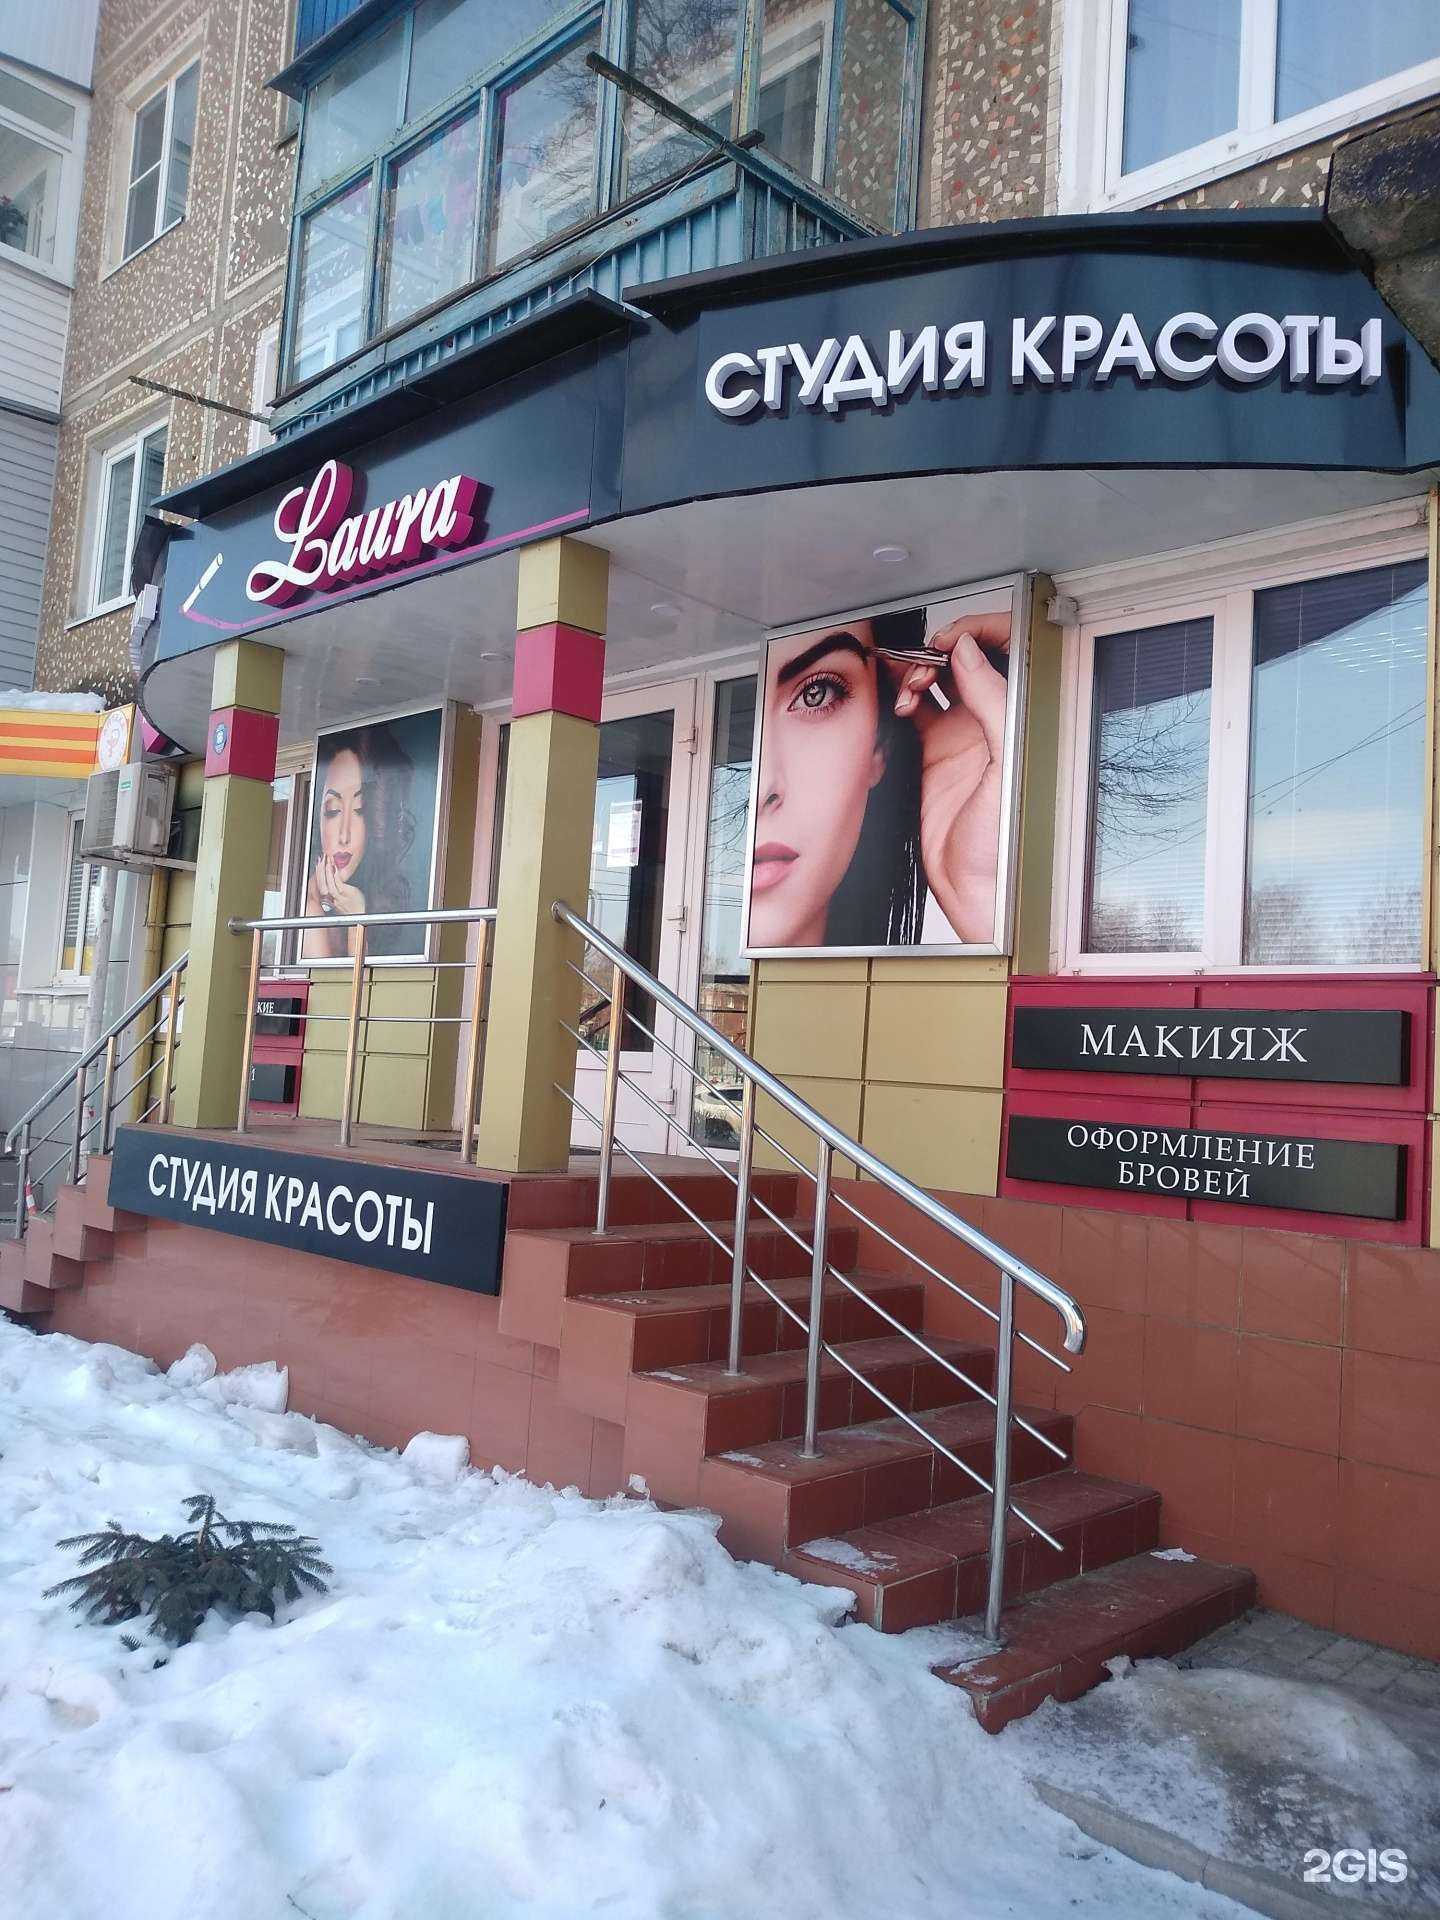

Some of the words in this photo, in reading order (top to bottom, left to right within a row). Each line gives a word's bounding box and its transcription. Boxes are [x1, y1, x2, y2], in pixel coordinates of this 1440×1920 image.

[704, 319, 986, 417] СТУДИЯ
[1011, 311, 1382, 384] КРАСОТЫ
[246, 459, 472, 604] Laura
[1080, 1023, 1308, 1063] МАКИЯЖ
[1066, 1124, 1315, 1169] ОФОРМЛЕНИЕ
[1118, 1161, 1251, 1198] БРОВЕЙ
[148, 1153, 258, 1216] СТУДИЯ
[264, 1173, 435, 1255] КРАСОТЫ
